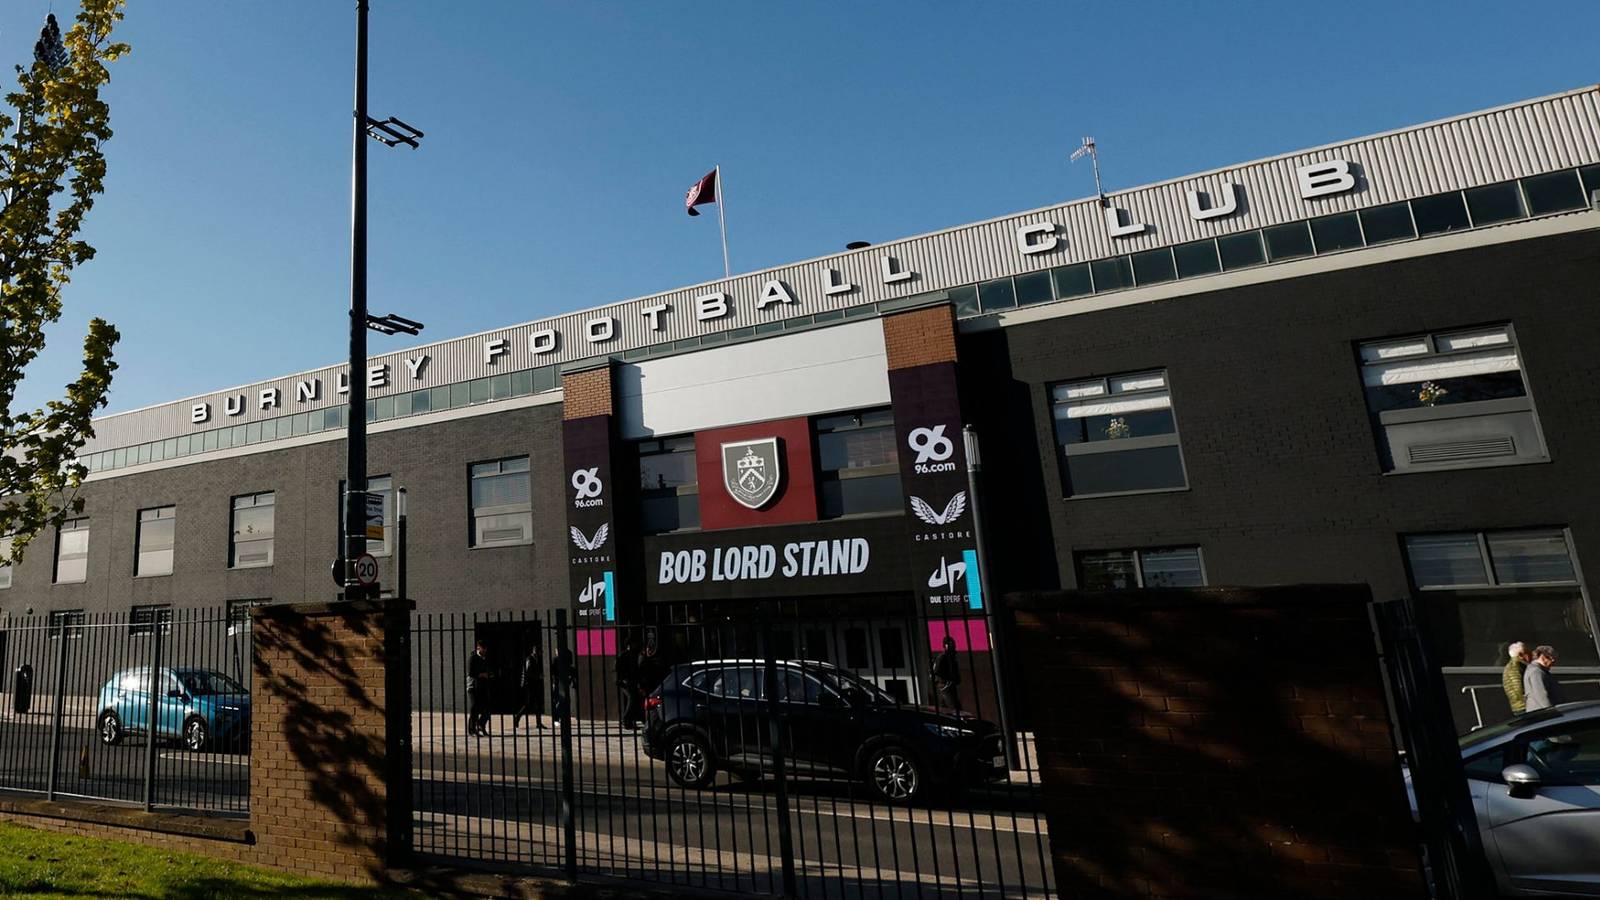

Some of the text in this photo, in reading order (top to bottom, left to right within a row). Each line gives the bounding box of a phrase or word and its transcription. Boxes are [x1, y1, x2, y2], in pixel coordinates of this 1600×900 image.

[191, 159, 1356, 423] BURNLEY FOOTBALL CLUB
[908, 424, 954, 464] 96
[914, 461, 956, 474] 96.com
[571, 467, 603, 499] 96
[575, 498, 604, 508] 96.com
[915, 530, 971, 542] CASTORE
[572, 555, 610, 565] CASTORE
[658, 538, 870, 584] BOB LORD STAND
[359, 563, 375, 577] 20
